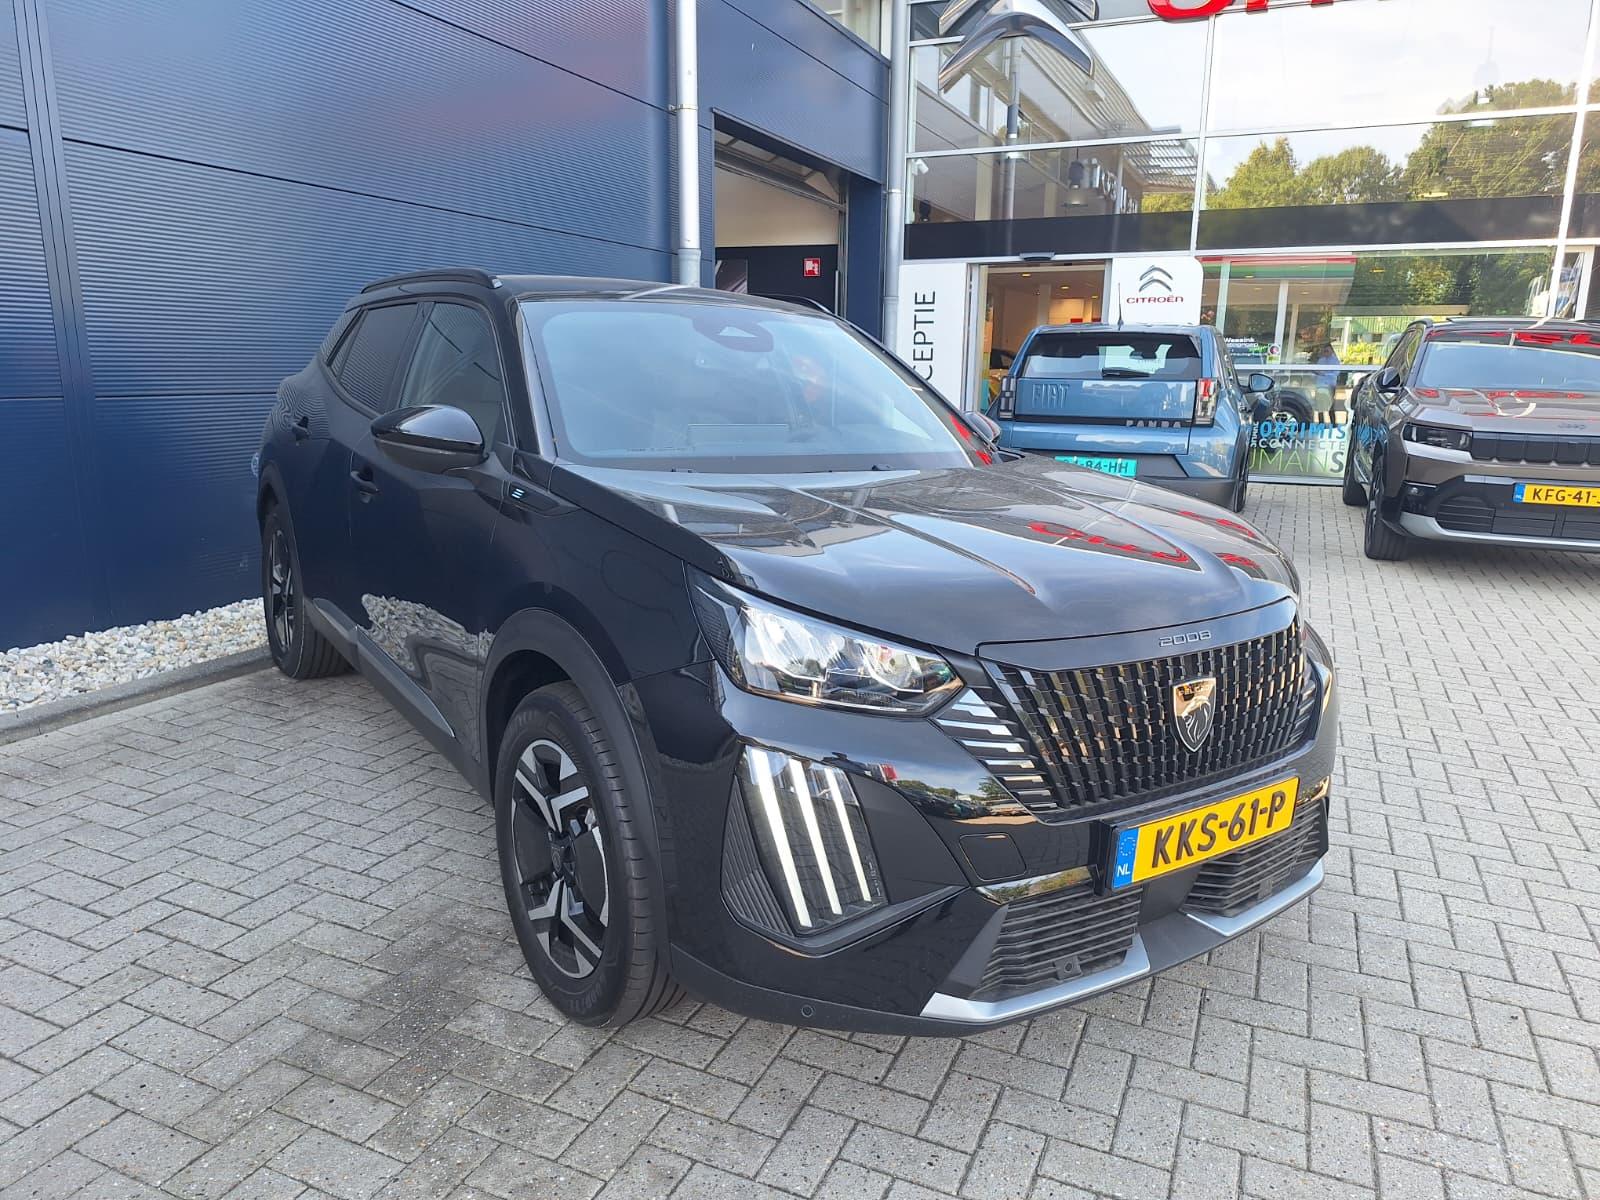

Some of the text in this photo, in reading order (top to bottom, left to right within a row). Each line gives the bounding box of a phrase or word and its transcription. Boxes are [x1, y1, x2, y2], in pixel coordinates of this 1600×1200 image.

[912, 291, 936, 381] CEPTIE
[1031, 384, 1070, 409] FIAT
[1126, 419, 1181, 428] PANDA
[1158, 629, 1211, 648] 2008
[1151, 790, 1286, 868] KKS-61-P
[1117, 864, 1131, 878] NL
